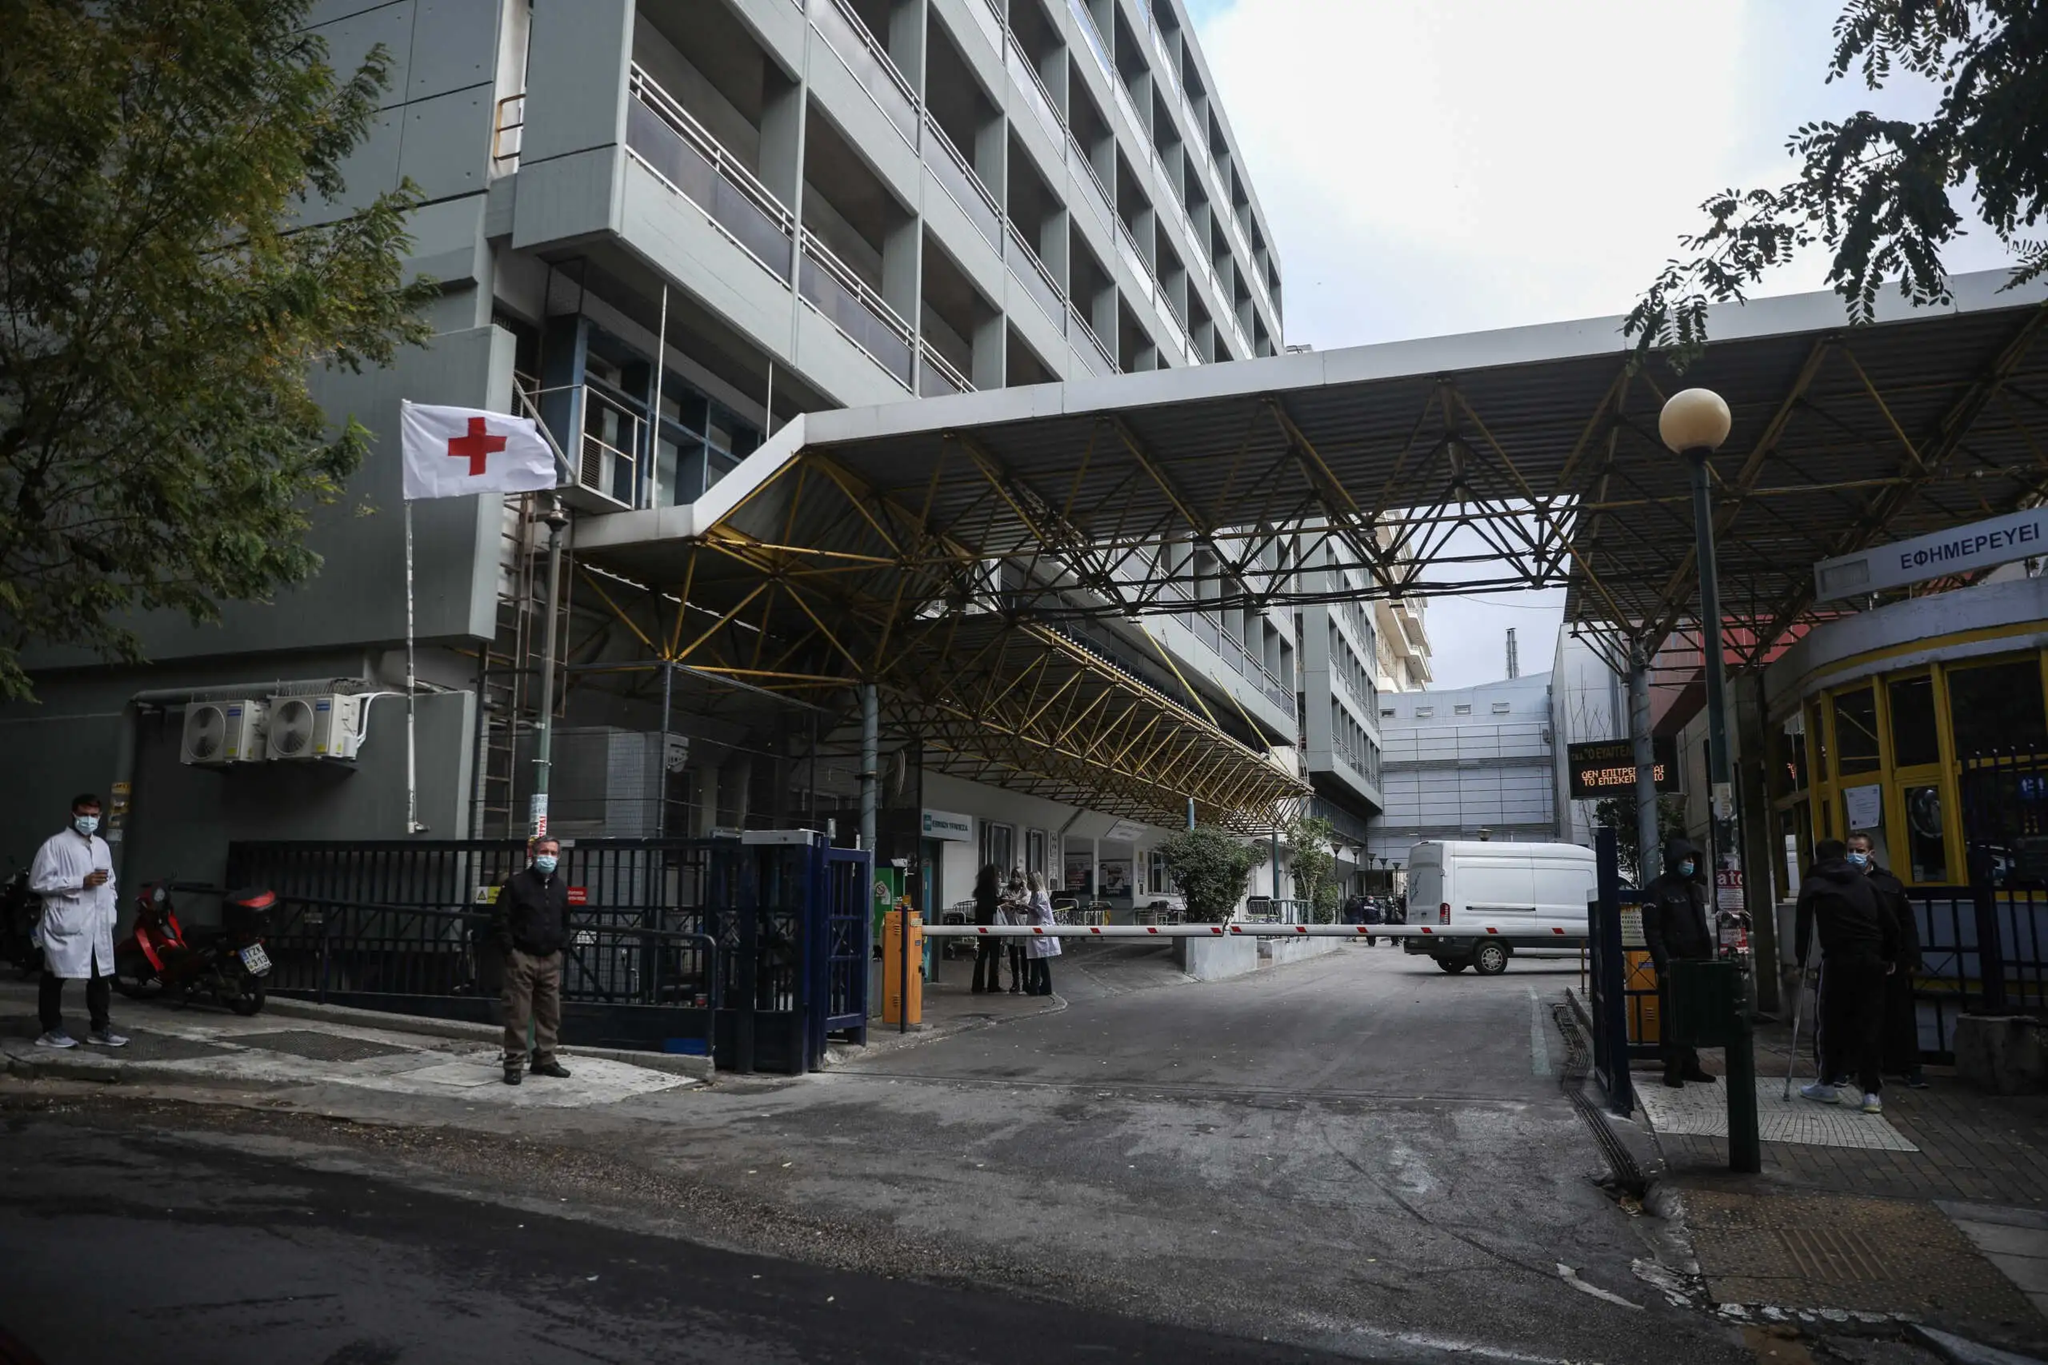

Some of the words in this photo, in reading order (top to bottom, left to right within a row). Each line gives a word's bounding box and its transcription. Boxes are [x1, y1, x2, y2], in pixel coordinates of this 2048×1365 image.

[1900, 522, 2040, 570] ΕΦΗΜΕΡΕΥΕΙ
[1601, 764, 1665, 777] ΕΠΙΤΡΕΑΙ
[1583, 778, 1595, 787] ΤΟ
[1598, 772, 1665, 786] ΕΠΙΣΚΕΠΙΟ
